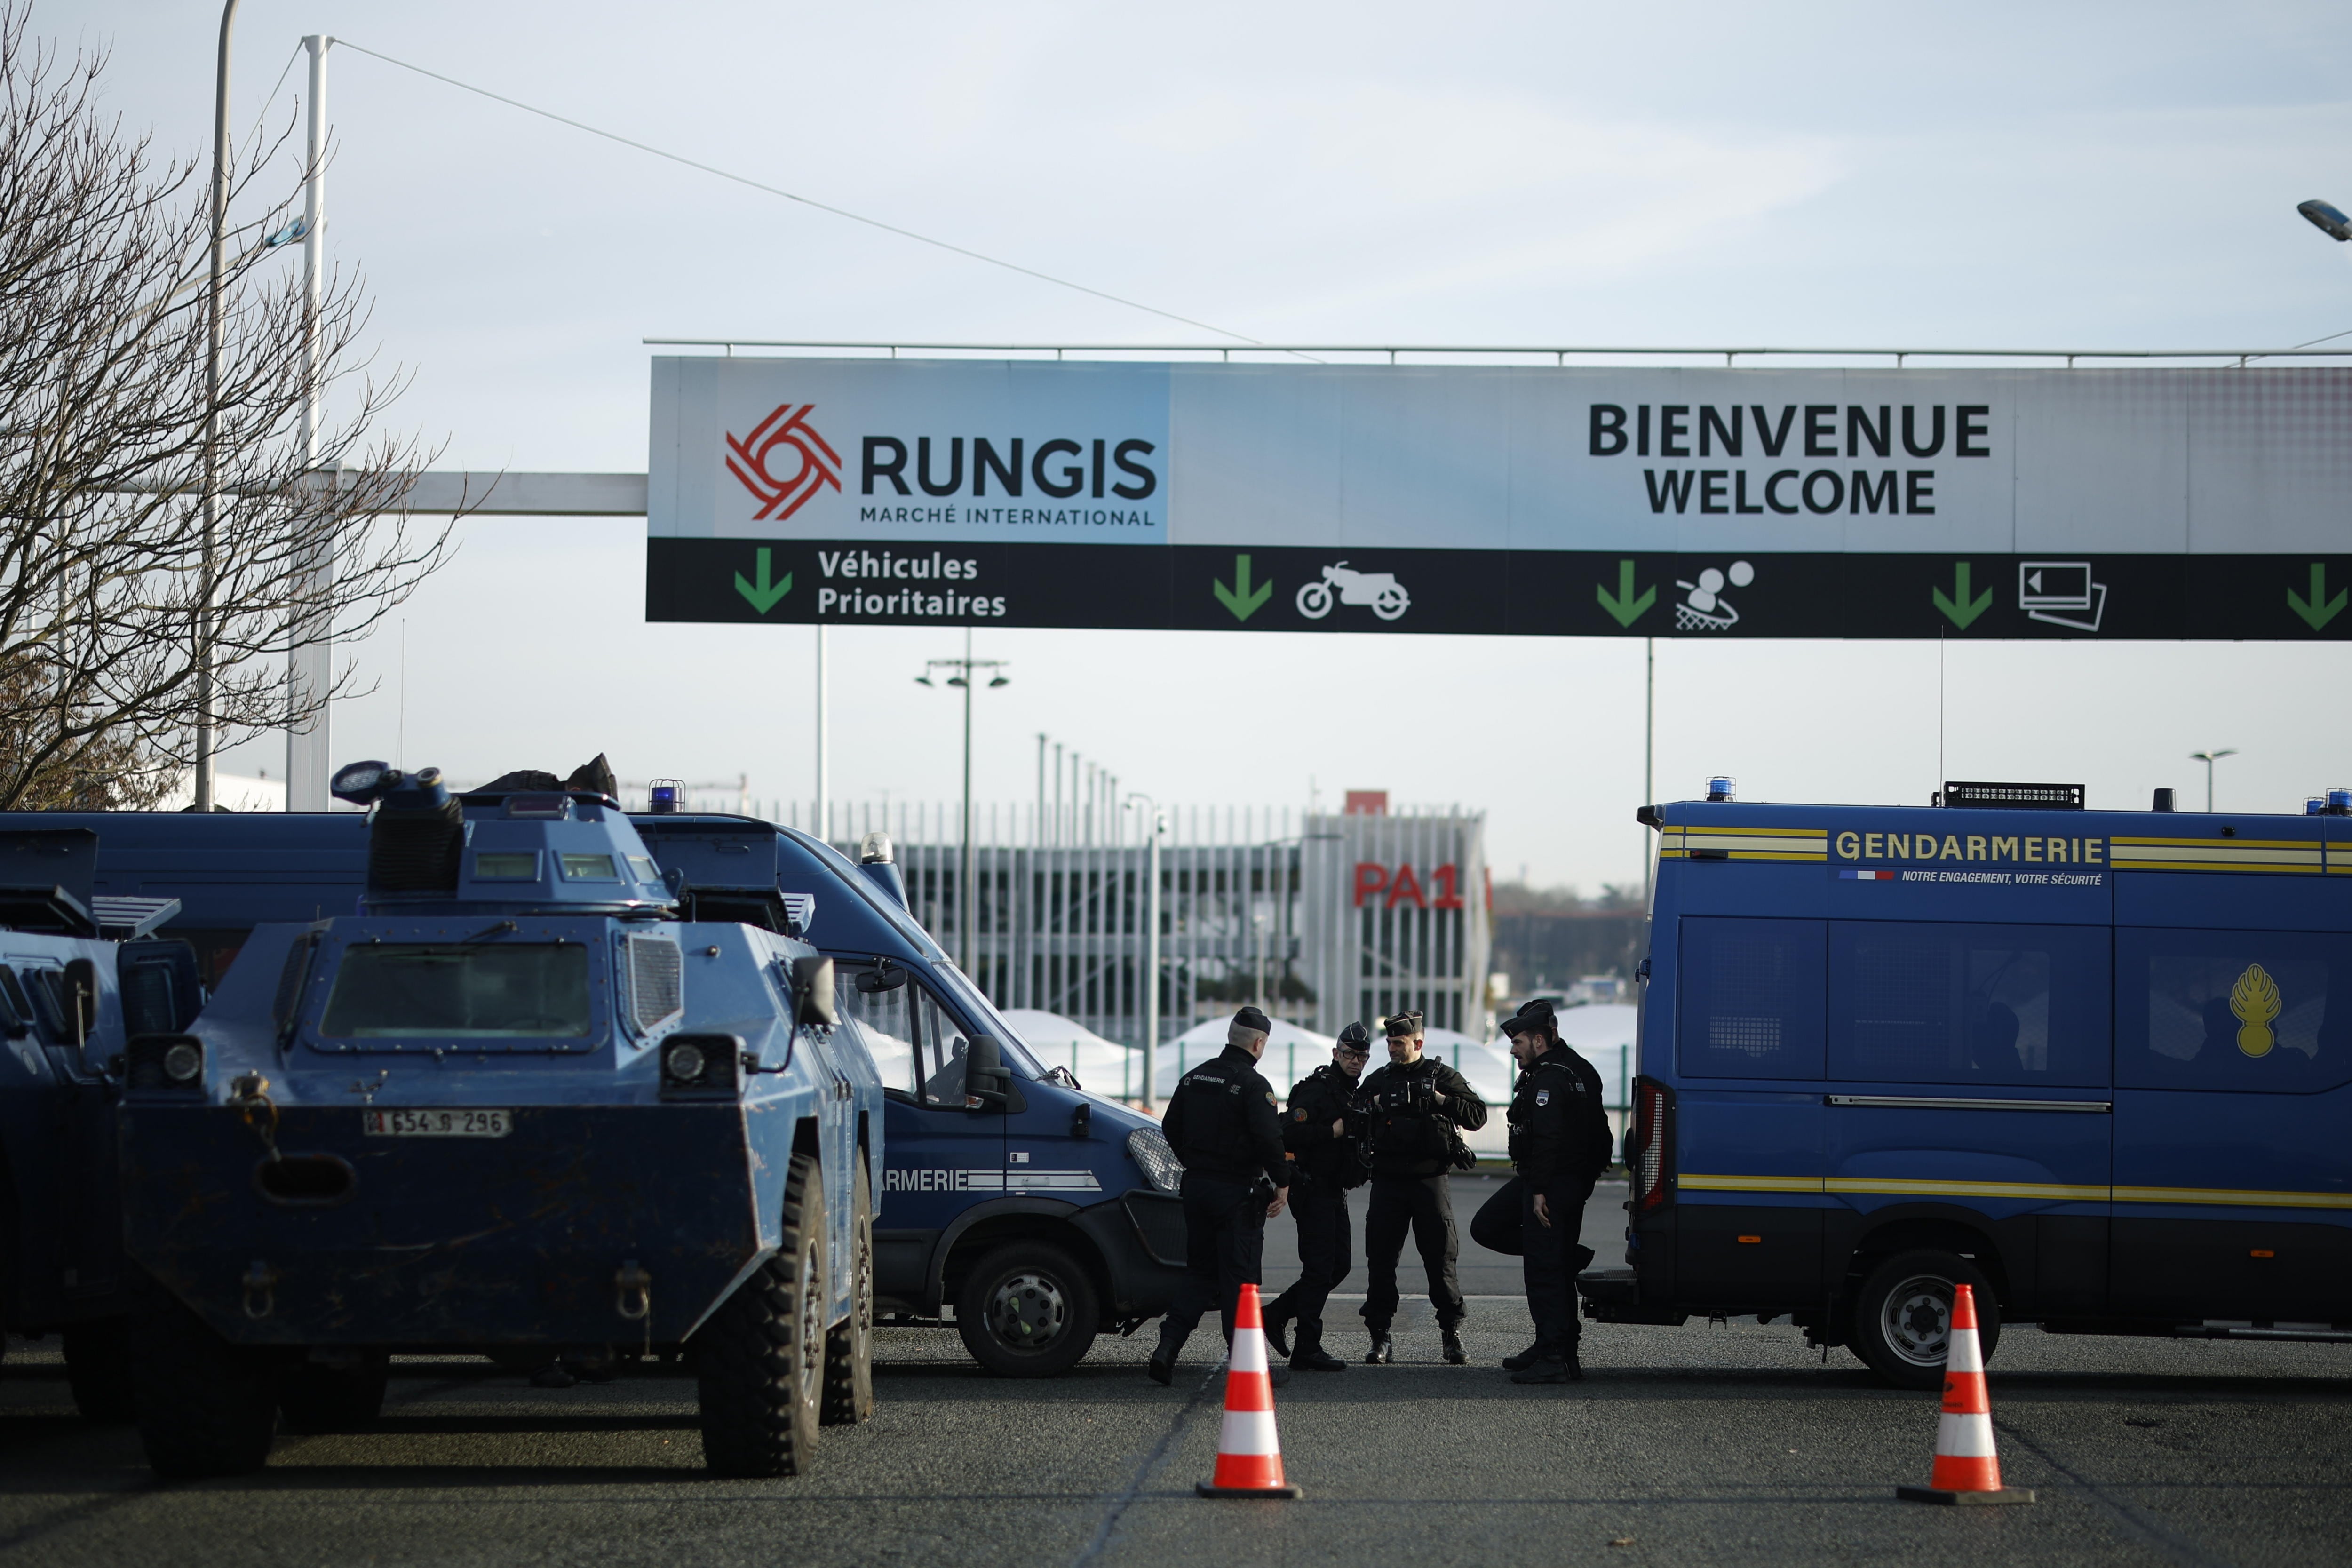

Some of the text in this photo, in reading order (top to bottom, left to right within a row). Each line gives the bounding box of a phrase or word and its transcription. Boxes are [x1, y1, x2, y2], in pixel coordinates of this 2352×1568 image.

[1589, 404, 1991, 458] BIENVENUE
[861, 436, 1157, 500] RUNGIS
[1644, 469, 1936, 515] WELCOME
[860, 503, 1156, 526] MARCHÉ INTERNATIONAL
[818, 550, 978, 580] Véhicules
[818, 587, 1006, 617] Prioritaires
[1836, 831, 2103, 864] GENDARMERIE
[1353, 862, 1464, 909] PA1
[1902, 871, 2102, 885] NOTRE ENGAGEMENT, VOTRE SÉCURITÉ
[1192, 1074, 1226, 1084] GENDARMERIE
[464, 1113, 503, 1132] 296
[883, 1170, 968, 1191] RMERIE
